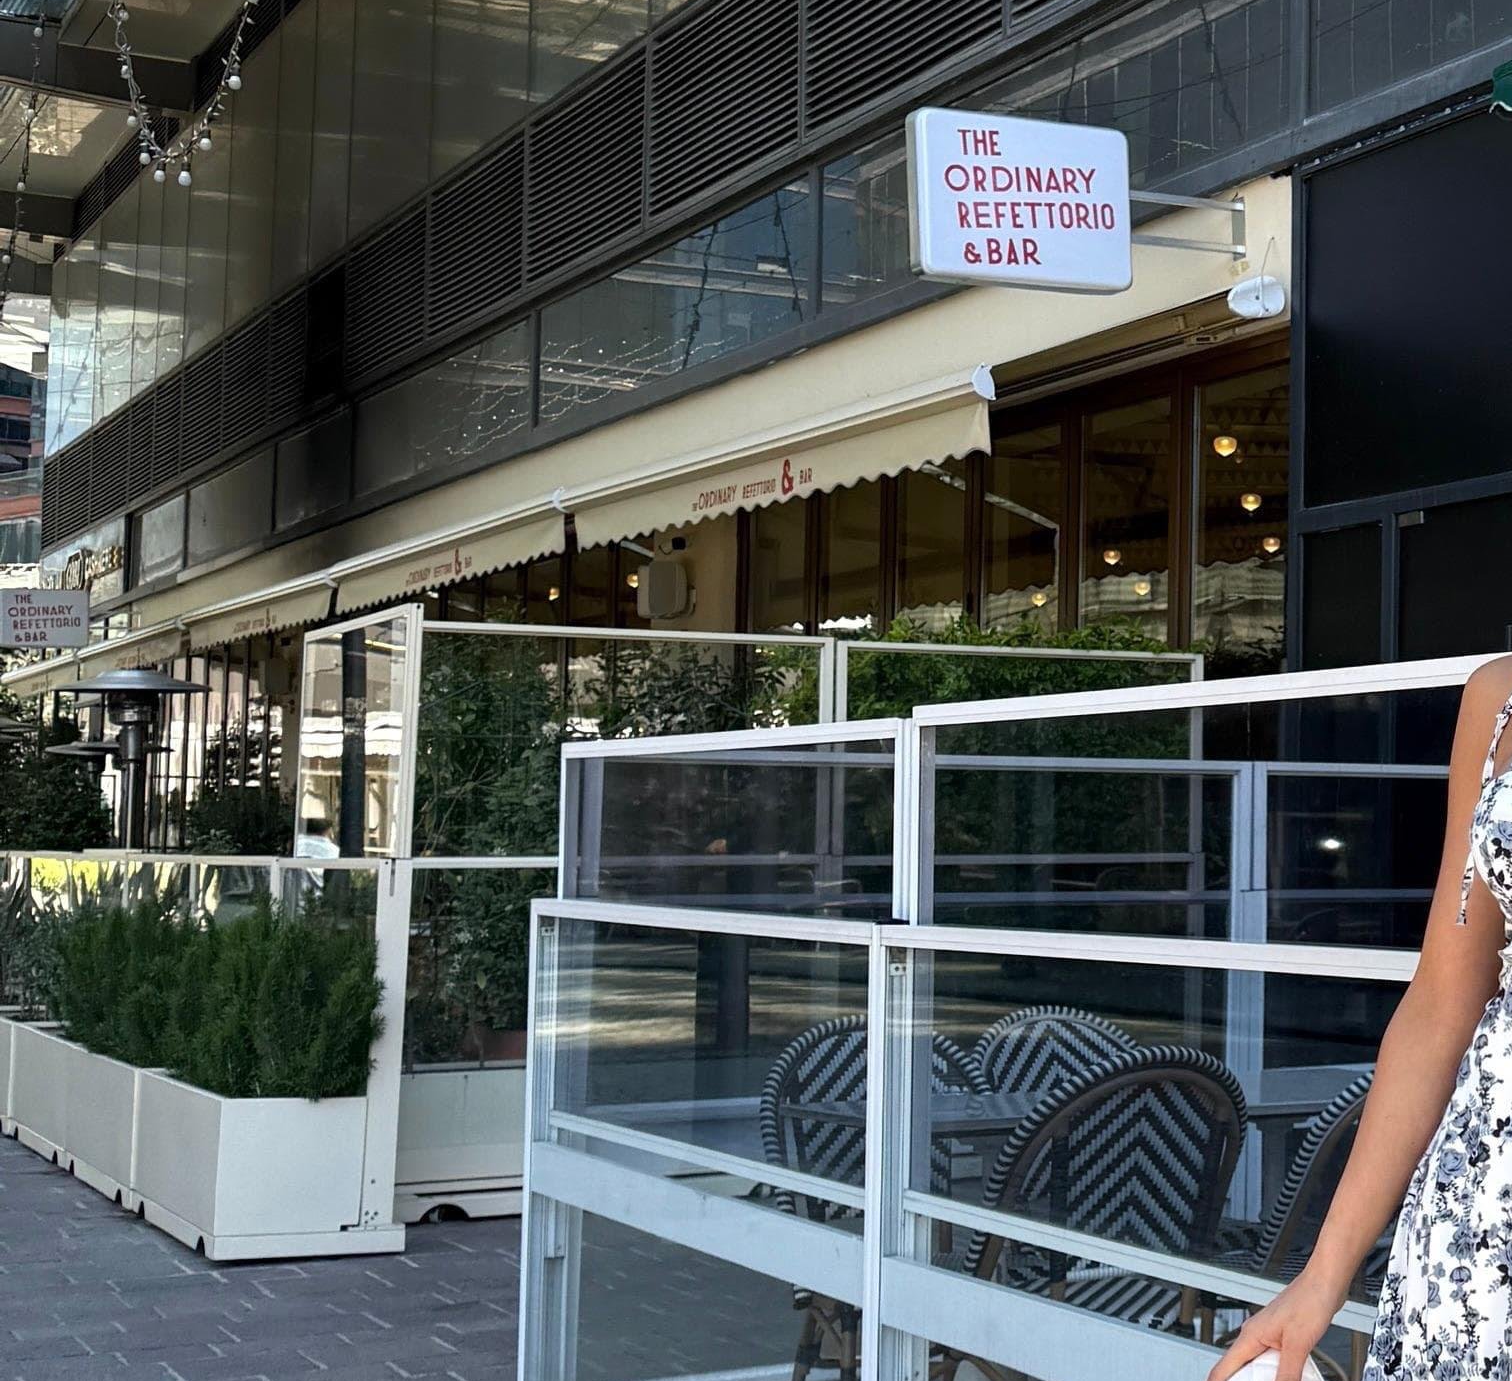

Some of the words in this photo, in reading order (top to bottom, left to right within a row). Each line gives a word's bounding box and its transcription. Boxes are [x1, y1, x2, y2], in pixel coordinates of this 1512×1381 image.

[957, 128, 1001, 156] THE
[944, 164, 1096, 194] ORDINARY
[957, 202, 1115, 230] REFETTORIO
[781, 458, 794, 496] &
[8, 605, 73, 617] ORDINARY
[15, 594, 32, 604] THE
[13, 618, 80, 630] REFETTORIO
